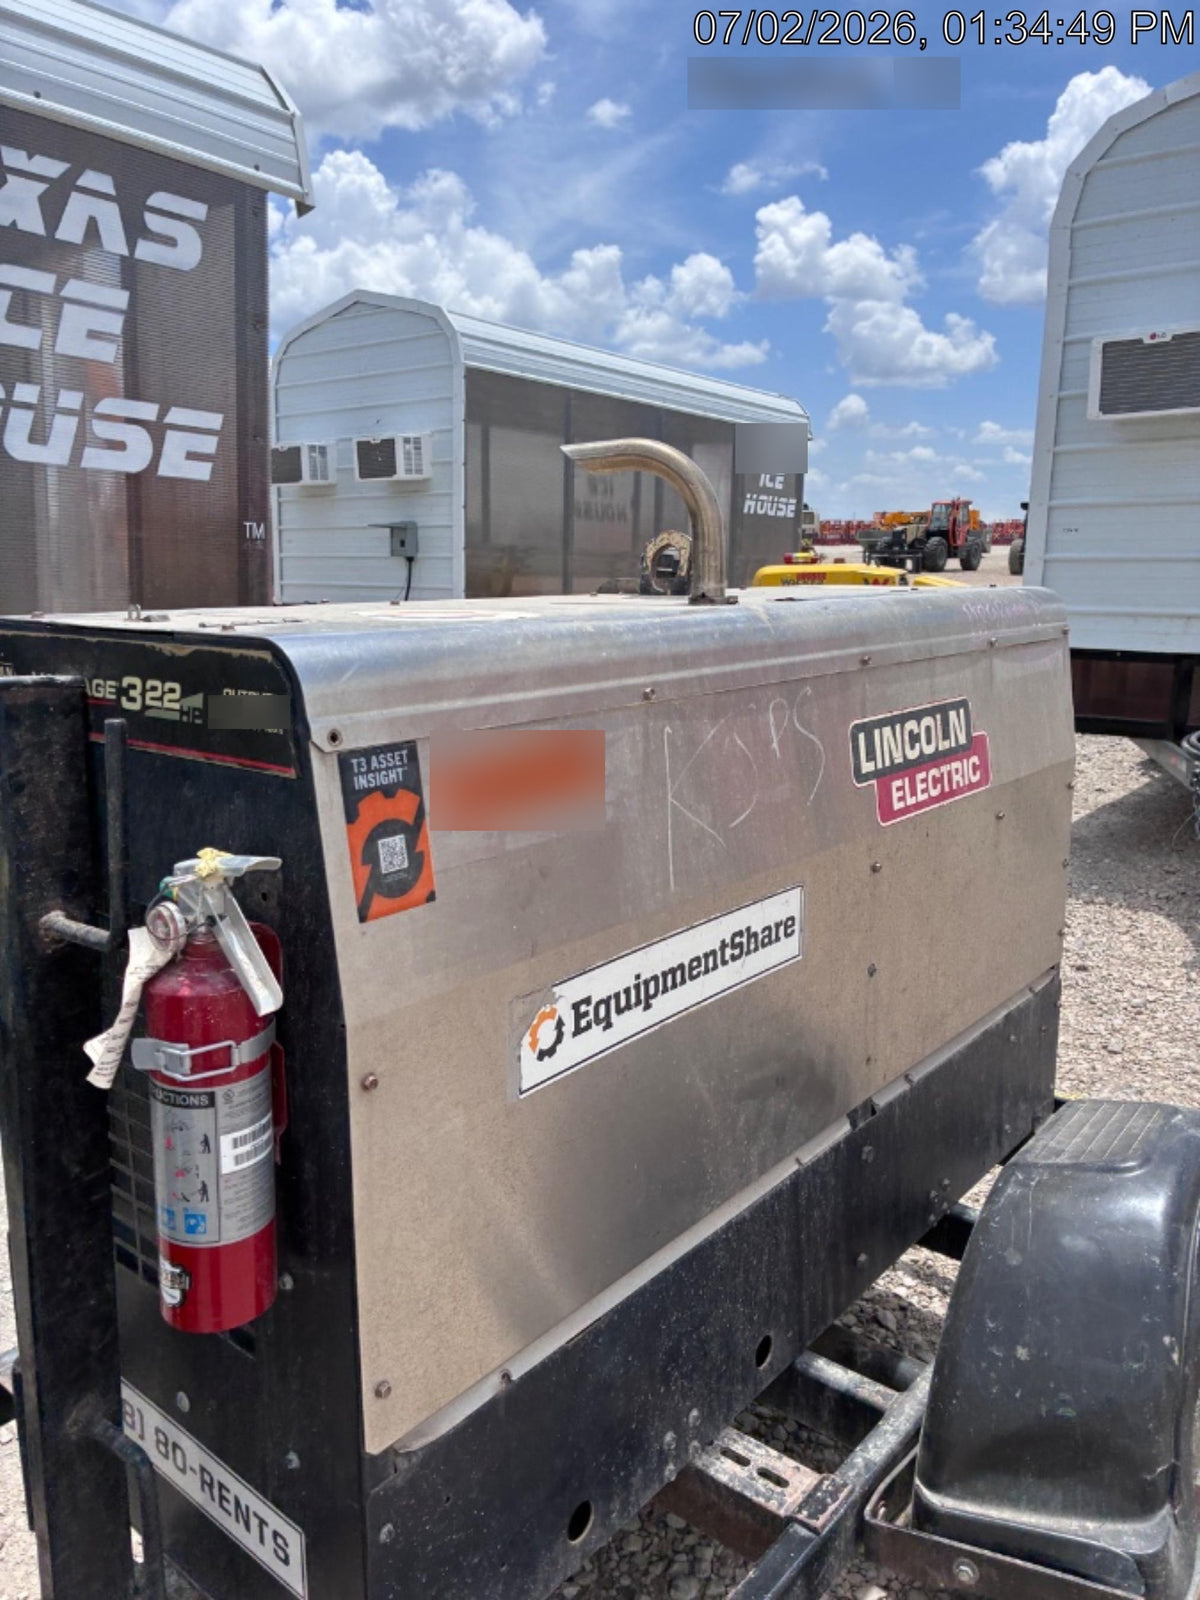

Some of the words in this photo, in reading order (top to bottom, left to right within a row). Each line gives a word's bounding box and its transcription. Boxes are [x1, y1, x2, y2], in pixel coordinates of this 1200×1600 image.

[0, 381, 224, 481] USE
[743, 493, 797, 518] HOUSE
[243, 521, 265, 539] TM
[120, 676, 181, 711] 322
[858, 708, 967, 774] LINCOLN
[351, 757, 367, 774] T3
[371, 749, 408, 770] ASSET
[353, 767, 404, 790] INSIGHT
[891, 755, 981, 811] ELECTRIC
[571, 914, 796, 1038] EquipmentShare
[151, 1087, 209, 1106] UCTIONS
[154, 1426, 290, 1567] 80-RENTS
